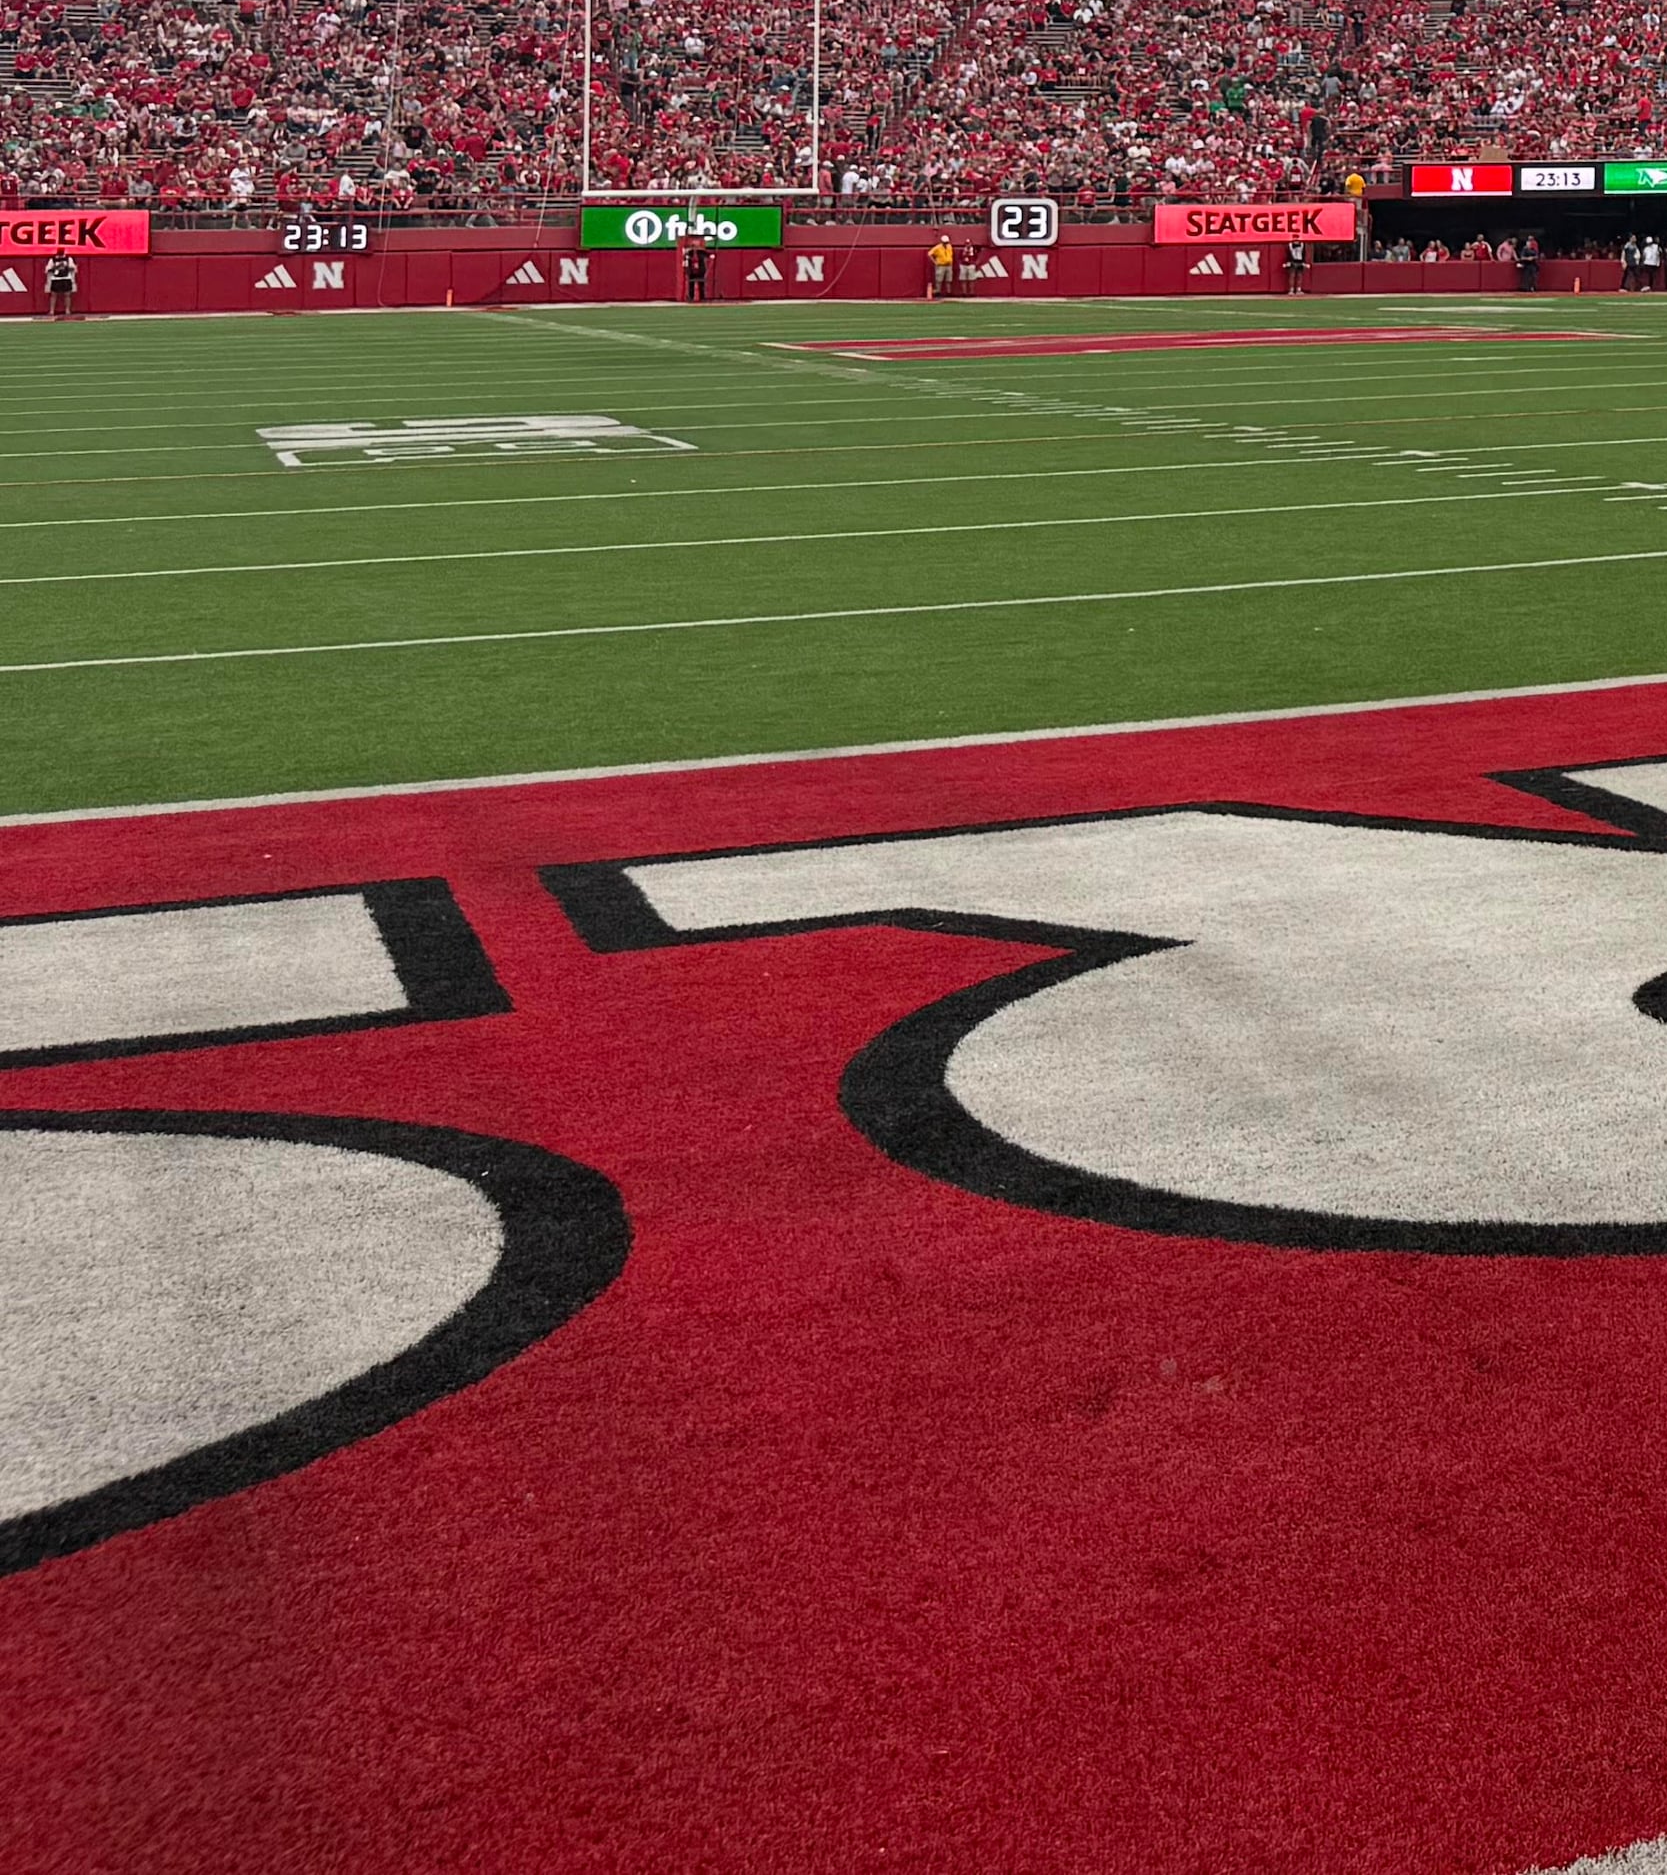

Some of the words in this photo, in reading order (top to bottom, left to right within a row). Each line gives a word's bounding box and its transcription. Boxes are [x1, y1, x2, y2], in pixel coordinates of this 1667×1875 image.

[1451, 167, 1474, 191] N
[1535, 172, 1582, 188] 23:13
[1001, 205, 1048, 240] 23
[1186, 208, 1325, 237] SEATGEEK
[283, 224, 369, 251] 23:13
[313, 261, 345, 290] N
[559, 257, 589, 285] N
[795, 255, 825, 283] N
[1021, 254, 1048, 280] N
[1235, 250, 1261, 276] N
